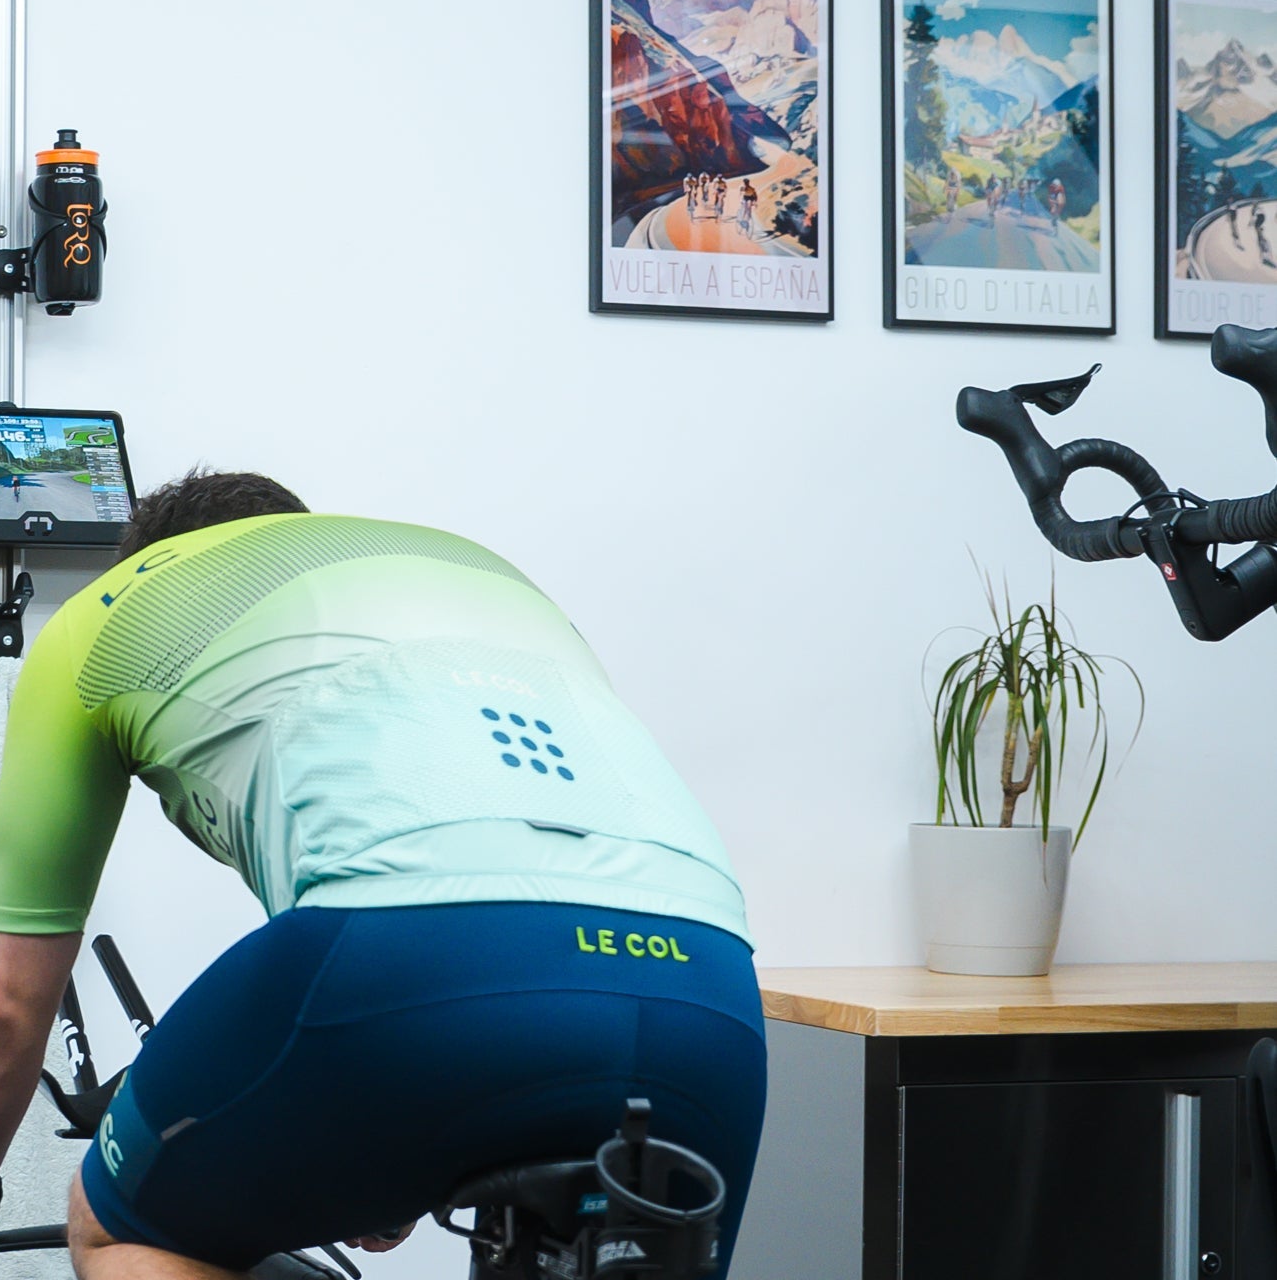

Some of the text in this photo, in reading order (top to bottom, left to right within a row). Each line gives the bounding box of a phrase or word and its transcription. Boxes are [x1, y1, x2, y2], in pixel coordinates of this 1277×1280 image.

[609, 259, 822, 302] VUELTA A ESPAÑA
[904, 276, 1101, 316] GIRO D'ITALIA
[1174, 289, 1230, 322] TOUR
[450, 671, 542, 699] LE COL
[575, 925, 691, 962] LE COL
